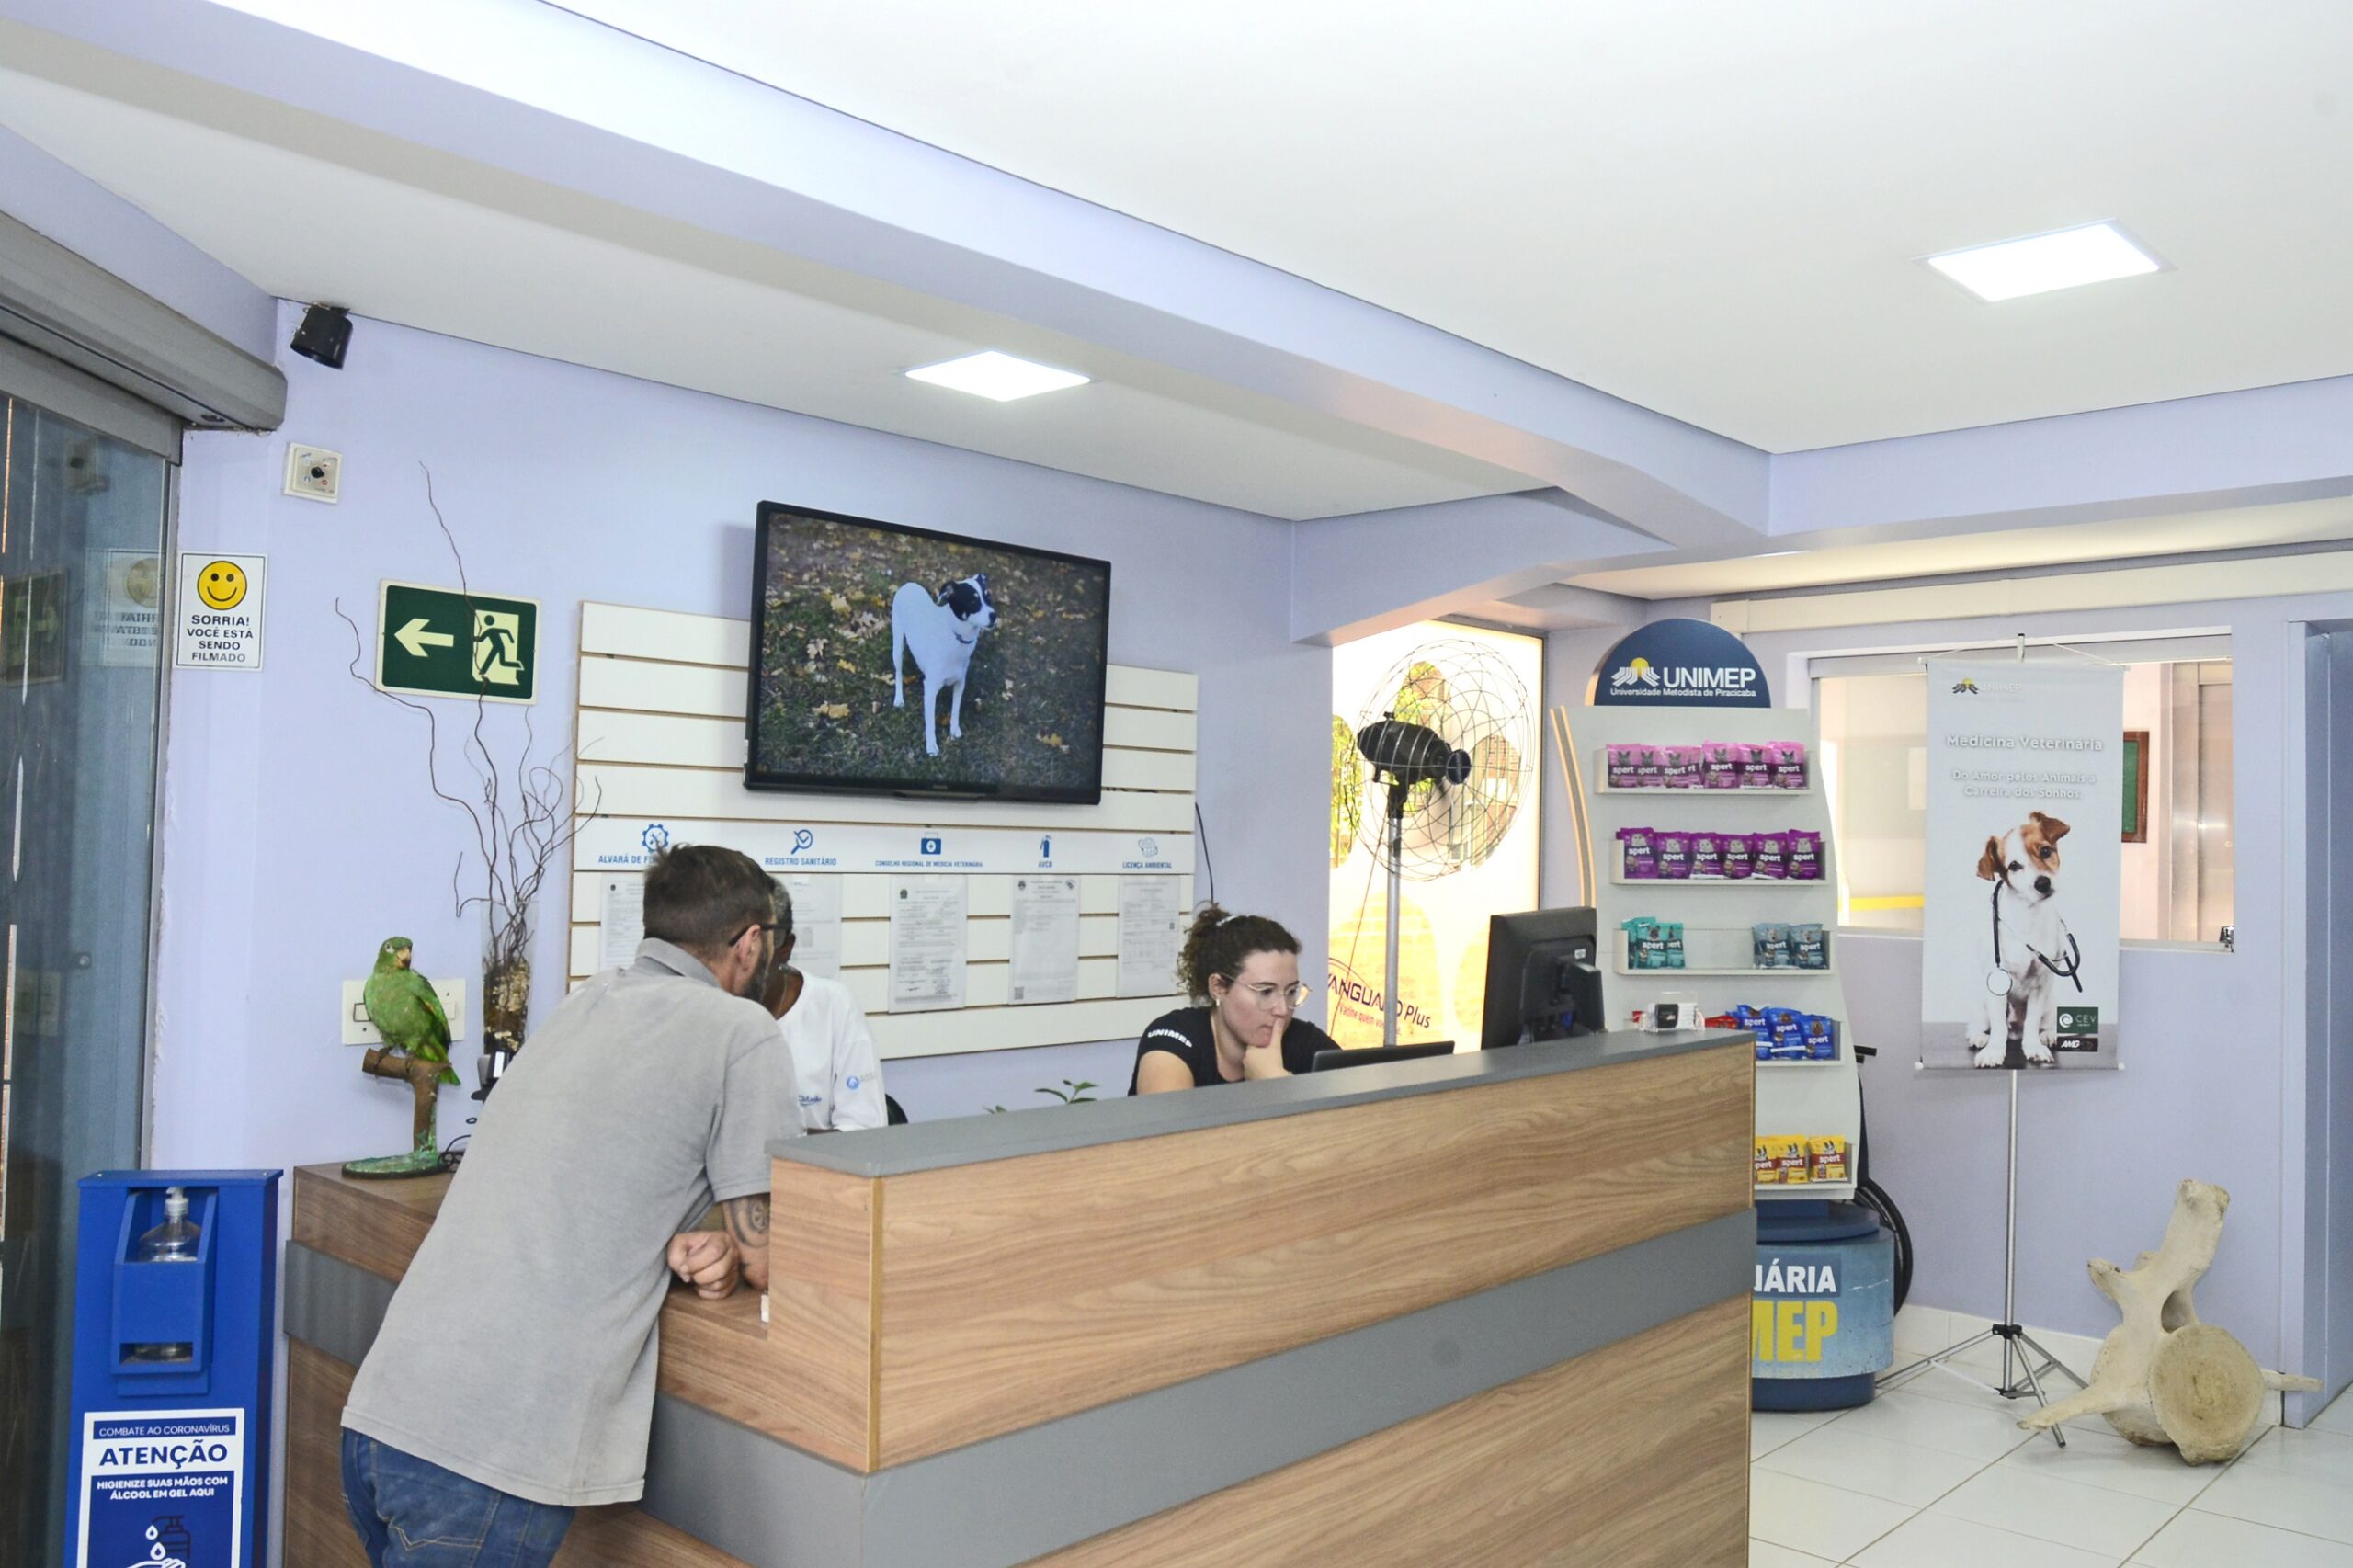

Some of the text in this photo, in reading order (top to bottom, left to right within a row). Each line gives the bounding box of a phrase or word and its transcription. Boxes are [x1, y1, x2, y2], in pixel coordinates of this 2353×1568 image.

[191, 615, 250, 626] SORRIA!
[187, 627, 253, 639] VOCÊ ESTÁ
[199, 641, 241, 650] SENDO
[191, 652, 246, 663] FILMADO
[1663, 667, 1756, 688] UNIMEP
[1663, 688, 1702, 697] Metodista
[1703, 688, 1713, 697] de
[1715, 688, 1756, 697] Piracicaba
[1946, 735, 2016, 748] Medicina
[598, 853, 629, 864] ALVARÁ
[631, 855, 642, 864] DE
[765, 857, 799, 866] REGISTRO
[1404, 1004, 1432, 1028] Plus
[2075, 1014, 2097, 1023] CEV
[1147, 1028, 1193, 1048] UNIMEP
[1755, 1161, 1772, 1170] pert
[99, 1424, 230, 1437] COMBATE AO CORONAVÍRUS
[99, 1439, 228, 1470] ATENÇÃO
[97, 1476, 228, 1490] HIGIENIZE SUAS MÃOS COM
[110, 1488, 215, 1500] ÁLCOOL EM GEL AQUI
